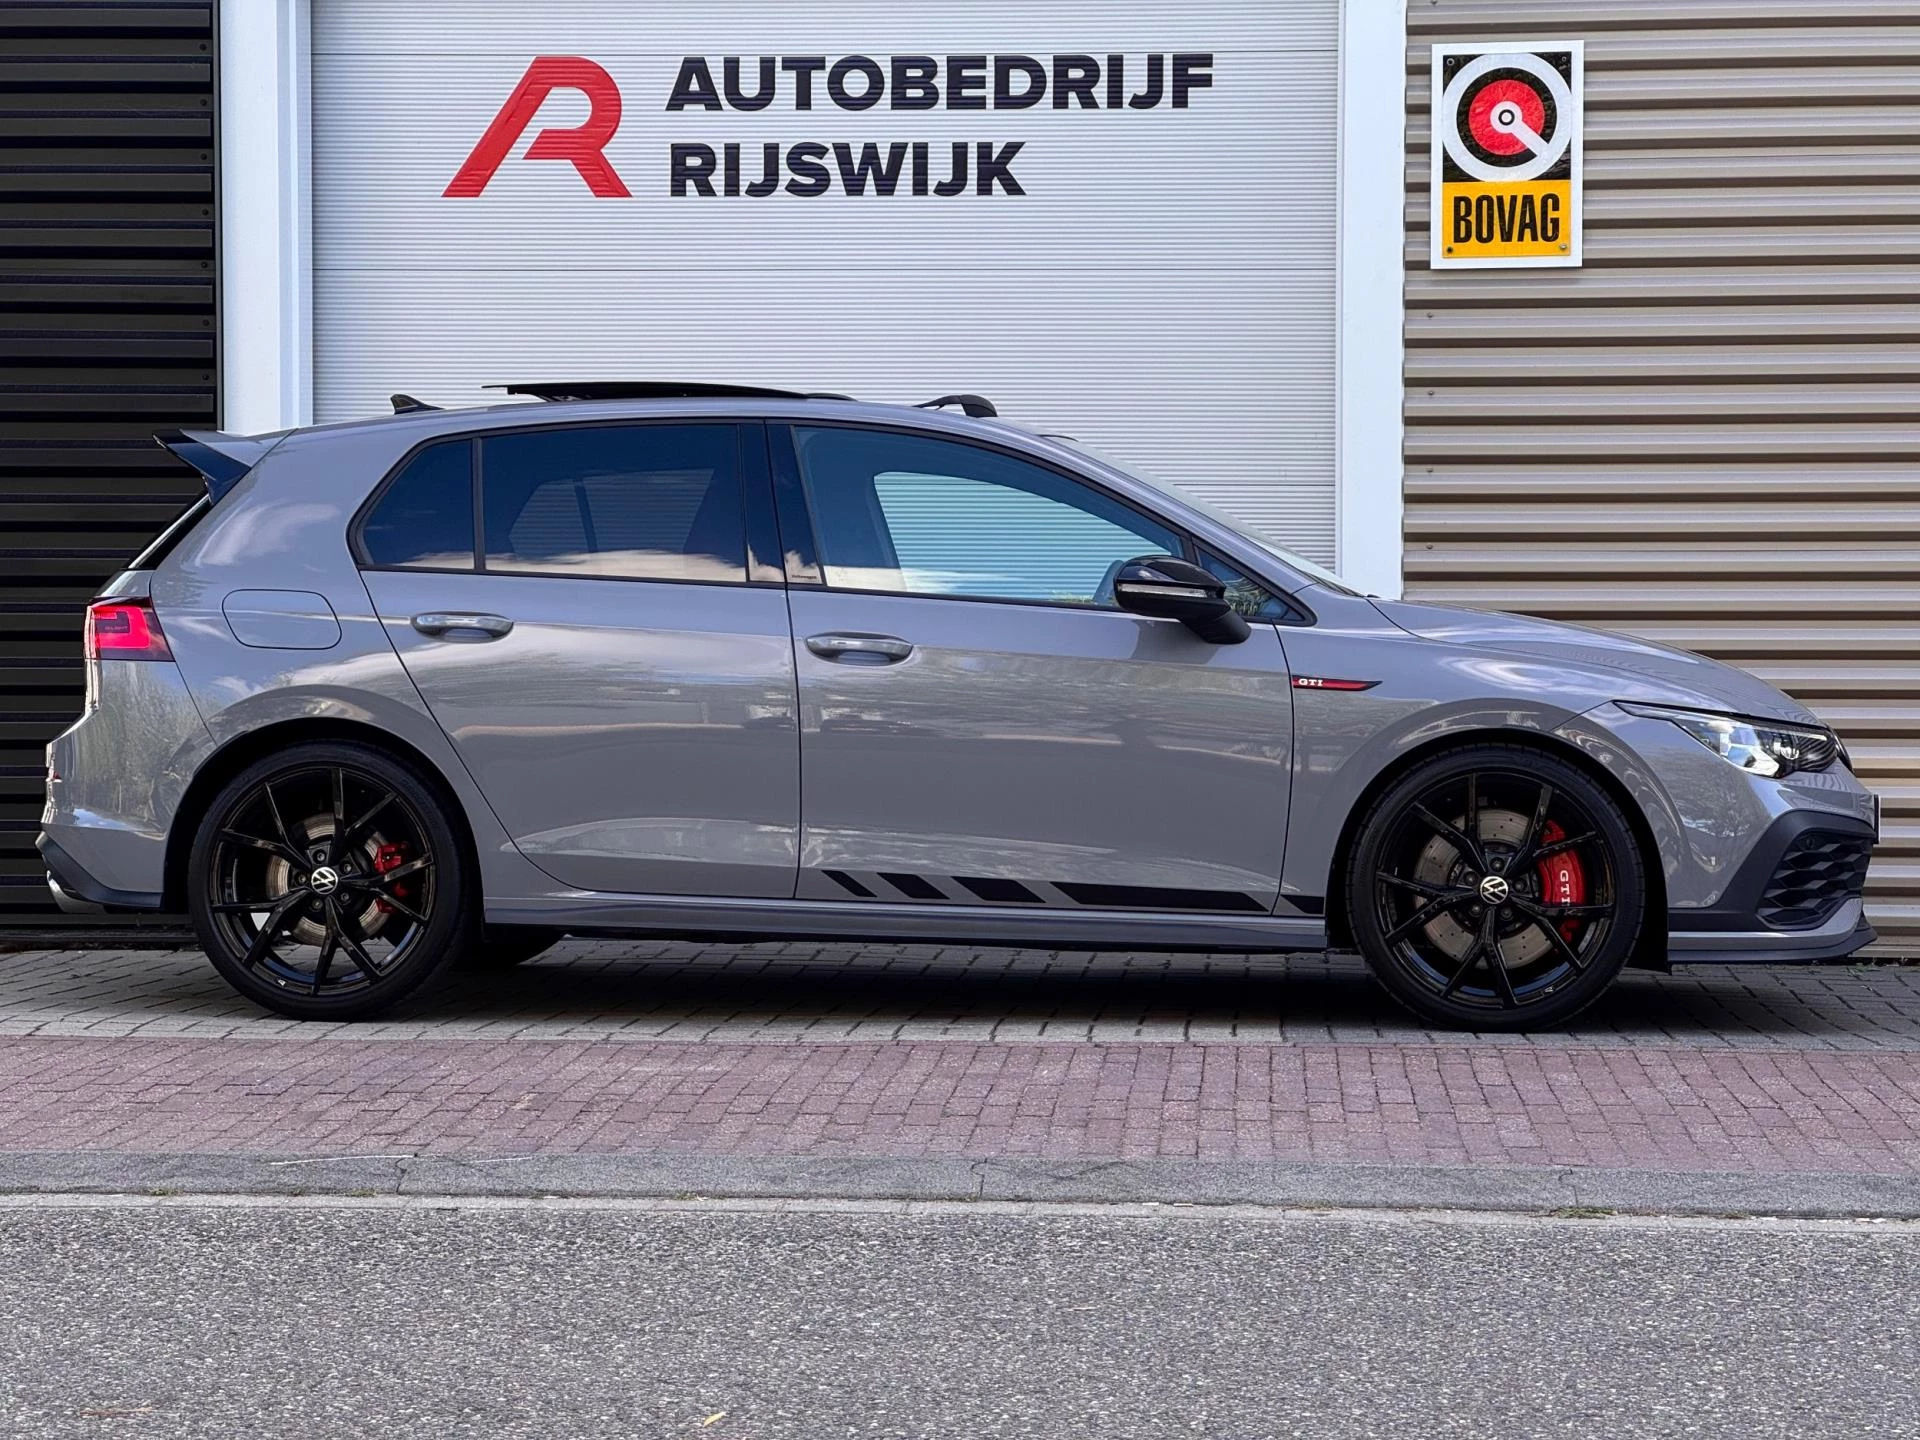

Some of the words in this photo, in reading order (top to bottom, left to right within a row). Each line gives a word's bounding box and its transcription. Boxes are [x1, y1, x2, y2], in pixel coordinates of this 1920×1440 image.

[666, 53, 1213, 112] AUTOBEDRIJF
[671, 141, 1025, 198] RIJSWIJK
[1453, 193, 1560, 244] BOVAG
[1298, 678, 1324, 687] GTI
